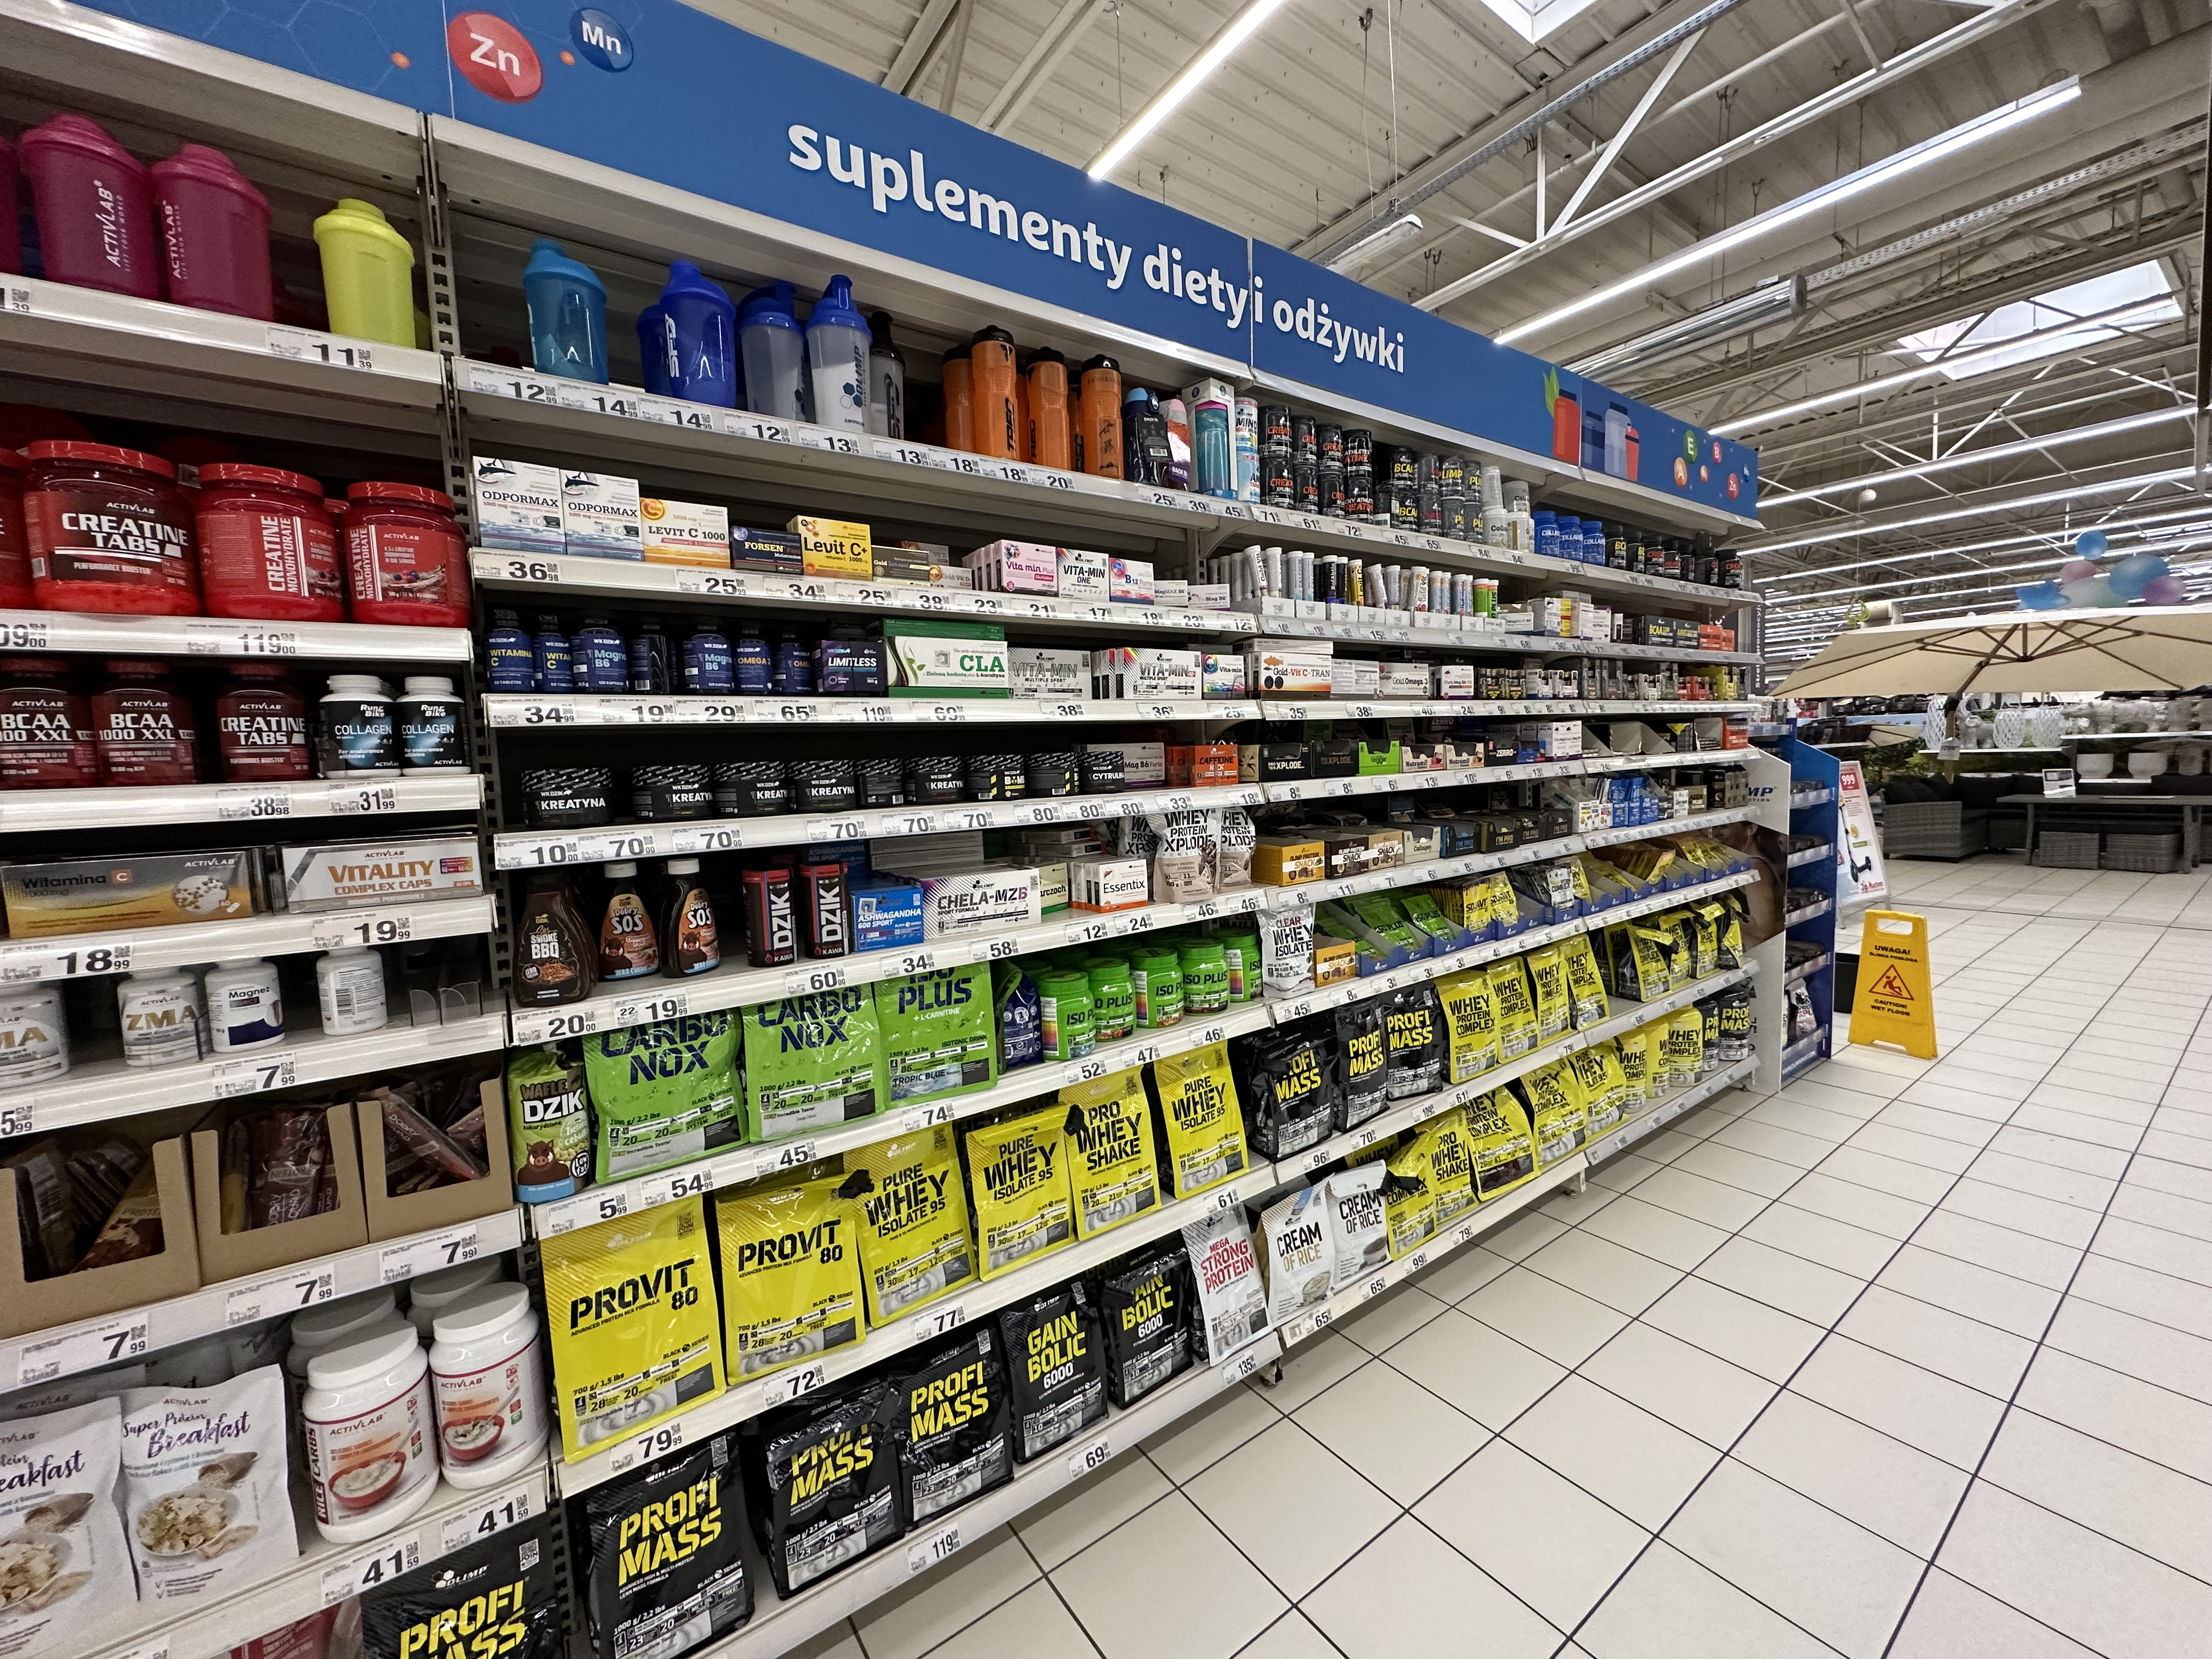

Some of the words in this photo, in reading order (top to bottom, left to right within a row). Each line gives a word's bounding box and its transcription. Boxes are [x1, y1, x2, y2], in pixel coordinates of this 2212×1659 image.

[582, 22, 622, 55] Mn
[470, 33, 521, 76] Zn
[94, 188, 120, 268] ACTIVLAB
[788, 125, 1132, 290] suplementy
[1143, 244, 1249, 329] diety
[1254, 276, 1263, 323] i
[1274, 297, 1406, 374] odżywki
[854, 345, 864, 396] OLIMP
[507, 382, 544, 399] 12
[592, 397, 627, 415] 14
[1687, 437, 1694, 455] E
[1714, 447, 1719, 458] B
[1678, 465, 1684, 479] A
[1729, 481, 1737, 491] Zn
[106, 502, 155, 515] ACTIVLAB
[482, 491, 558, 507] ODPORMAX
[568, 502, 637, 518] ODPORMAX
[61, 512, 188, 546] CREATINE
[648, 526, 685, 538] LEVIT
[689, 528, 698, 538] C
[702, 532, 725, 541] 1000
[92, 532, 160, 555] TABS
[804, 537, 845, 554] Levit
[260, 516, 285, 593] CREATINE
[280, 517, 300, 595] MONOHYDRATE
[350, 529, 365, 601] CREATINE
[509, 561, 548, 580] 36
[705, 578, 737, 595] 25
[490, 650, 532, 658] WITAMINA
[828, 657, 877, 667] LIMITLESS
[960, 654, 1004, 672] CLA
[111, 714, 173, 728] BCAA
[221, 716, 306, 734] CREATINE
[524, 706, 563, 723] 34
[141, 730, 176, 741] XXL
[237, 731, 287, 745] TABS
[335, 724, 392, 736] COLLAGEN
[402, 723, 454, 736] COLLAGEN
[1841, 774, 1855, 786] 999
[251, 797, 275, 816] 38
[275, 806, 289, 815] 98
[359, 792, 382, 811] 31
[382, 800, 395, 810] 99
[541, 797, 605, 809] KREATYNA
[1032, 807, 1053, 821] 80
[531, 844, 566, 864] 10
[567, 853, 578, 861] 00
[608, 838, 645, 856] 70
[22, 873, 106, 890] Witamina
[327, 860, 435, 883] VITALITY
[334, 882, 396, 894] COMPLEX
[400, 879, 432, 890] CAPS
[1103, 880, 1146, 894] Essentix
[611, 915, 644, 934] SOS
[687, 911, 712, 928] SOS
[773, 889, 791, 949] DZIK
[820, 886, 840, 942] DZIK
[857, 908, 922, 922] ASHWAGANDHA
[1276, 917, 1301, 928] CLEAR
[354, 921, 398, 943] 19
[397, 931, 410, 939] 99
[1272, 924, 1312, 943] WHEY
[531, 942, 558, 958] BBQ
[990, 941, 1012, 957] 58
[1276, 941, 1312, 956] ISOLATE
[1874, 945, 1910, 955] UWAGA!
[57, 950, 113, 973] 18
[114, 959, 129, 969] 99
[810, 972, 837, 989] 60
[229, 986, 270, 999] Magnez
[898, 978, 973, 1013] PLUS
[1875, 998, 1908, 1008] CAUTION!
[1449, 997, 1490, 1016] WHEY
[1457, 1011, 1491, 1023] PROTEIN
[1887, 1008, 1910, 1016] FLOOR
[126, 1007, 198, 1031] ZMA
[548, 1015, 585, 1036] 20
[586, 1023, 596, 1031] 00
[1388, 1011, 1430, 1032] PROFI
[1457, 1018, 1495, 1036] COMPLEX
[781, 1017, 850, 1053] NOX
[1205, 1028, 1221, 1043] 46
[1388, 1026, 1433, 1051] MASS
[630, 1043, 709, 1086] NOX
[256, 1066, 280, 1089] 7
[281, 1075, 295, 1084] 99
[1184, 1076, 1211, 1094] PURE
[1277, 1069, 1321, 1102] MASS
[524, 1090, 583, 1124] DZIK
[1172, 1082, 1226, 1121] WHEY
[1077, 1112, 1142, 1154] WHEY
[1438, 1133, 1457, 1147] PRO
[999, 1134, 1034, 1159] PURE
[1087, 1138, 1140, 1171] SHAKE
[883, 1163, 923, 1188] PURE
[984, 1141, 1057, 1190] WHEY
[1436, 1160, 1468, 1180] SHAKE
[672, 1173, 703, 1199] 54
[994, 1173, 1037, 1201] ISOLATE
[600, 1198, 616, 1220] 5
[865, 1169, 949, 1229] WHEY
[1217, 1192, 1233, 1208] 61
[1339, 1191, 1380, 1220] CREAM
[878, 1203, 928, 1238] ISOLATE
[1346, 1217, 1358, 1233] OF
[1359, 1209, 1383, 1231] RICE
[739, 1220, 842, 1272] PROVIT
[1209, 1238, 1229, 1253] MEGA
[1277, 1222, 1321, 1257] CREAM
[1201, 1239, 1248, 1277] STRONG
[1283, 1254, 1296, 1272] OF
[1299, 1247, 1322, 1269] RICE
[1205, 1257, 1254, 1294] PROTEIN
[570, 1259, 696, 1329] PROVIT
[1370, 1279, 1384, 1294] 65
[672, 1286, 698, 1311] 80
[1122, 1285, 1173, 1330] BOLIC
[1028, 1312, 1077, 1356] GAIN
[102, 1333, 128, 1359] 7
[130, 1342, 146, 1352] 99
[1028, 1329, 1086, 1383] BOLIC
[910, 1361, 984, 1412] PROFI
[1043, 1363, 1073, 1389] 6000
[911, 1387, 989, 1442] MASS
[123, 1419, 161, 1437] Super
[148, 1412, 251, 1457] Breakfast
[330, 1415, 383, 1436] ACTIVLAB
[639, 1426, 672, 1459] 79
[672, 1435, 682, 1445] 99
[1086, 1447, 1105, 1468] 69
[791, 1437, 874, 1505] MASS
[619, 1476, 718, 1549] PROFI
[618, 1509, 721, 1586] MASS
[362, 1549, 405, 1584] 41
[400, 1582, 524, 1656] PROFI
